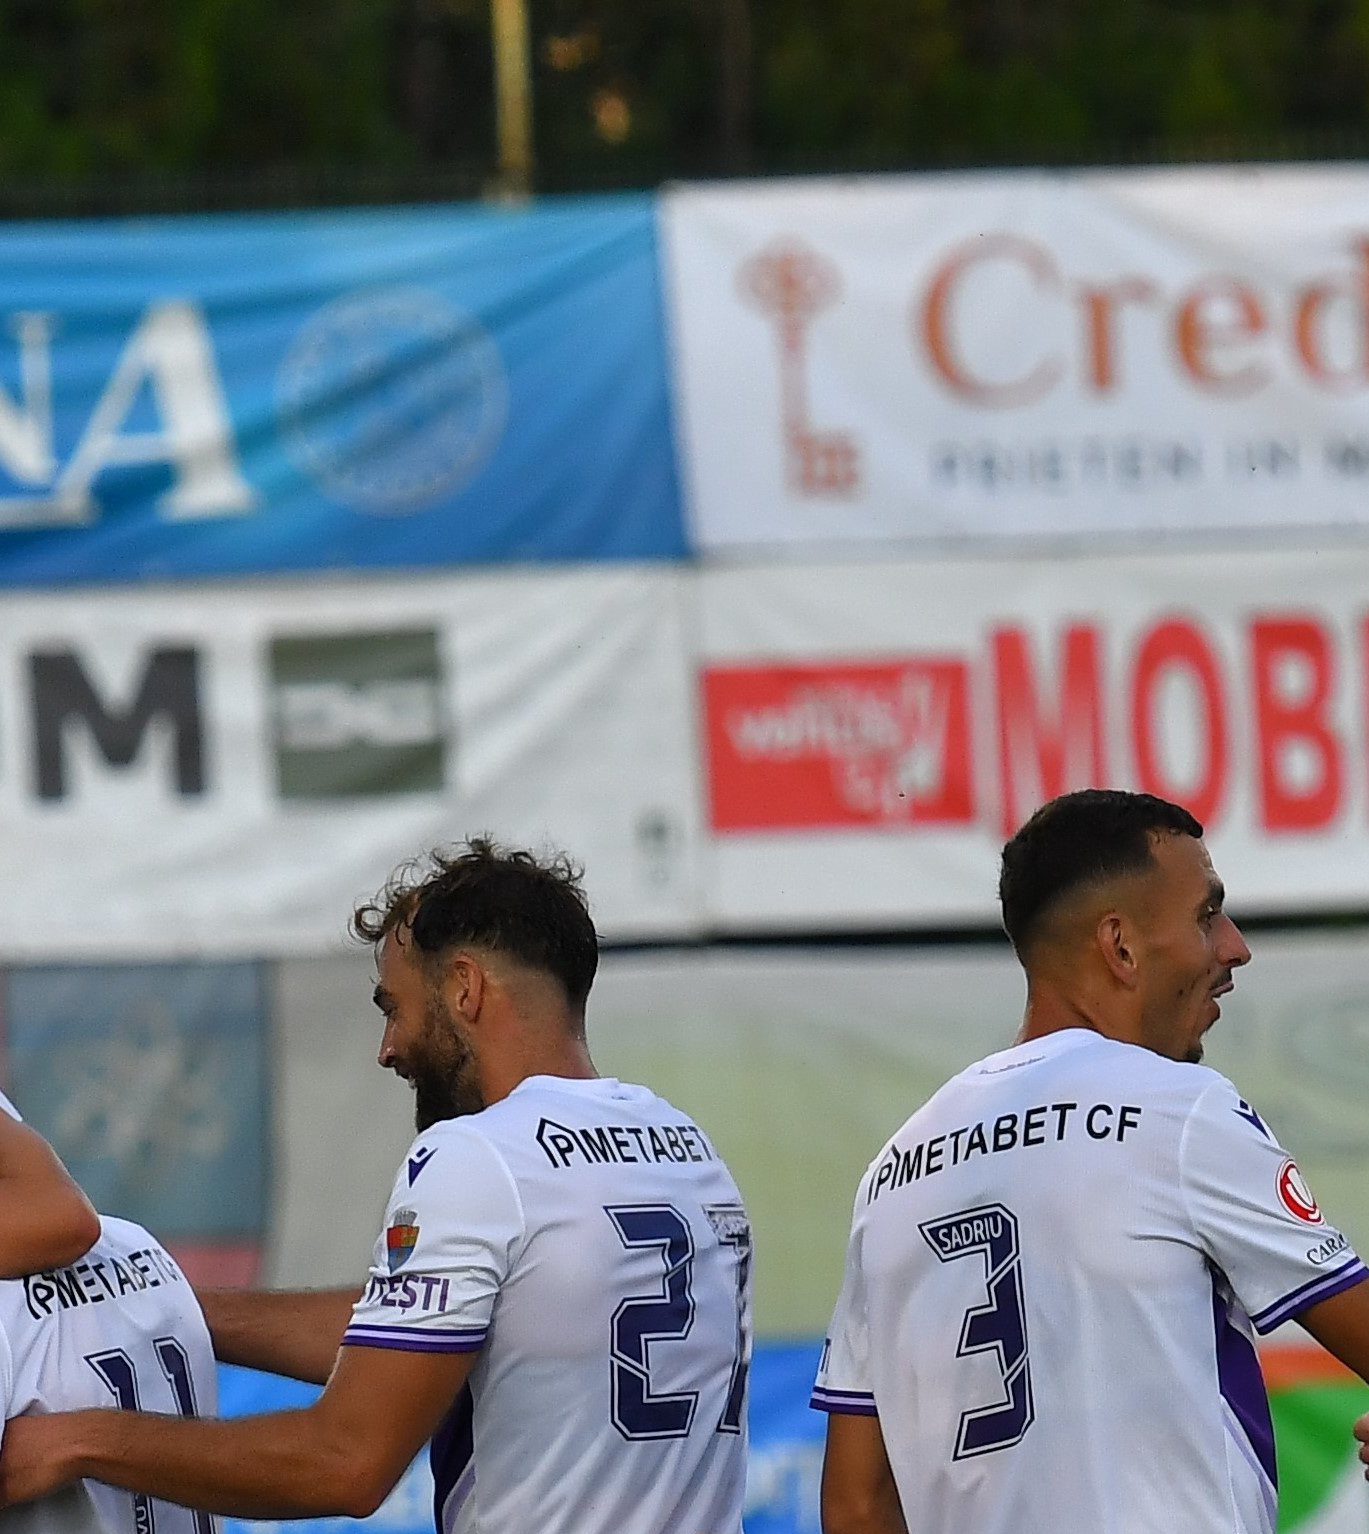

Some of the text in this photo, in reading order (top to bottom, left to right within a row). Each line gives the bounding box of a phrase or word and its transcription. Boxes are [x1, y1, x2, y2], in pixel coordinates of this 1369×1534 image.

[1085, 1104, 1142, 1143] CF
[938, 1214, 1003, 1252] SADRIU
[918, 1202, 1035, 1461] 3
